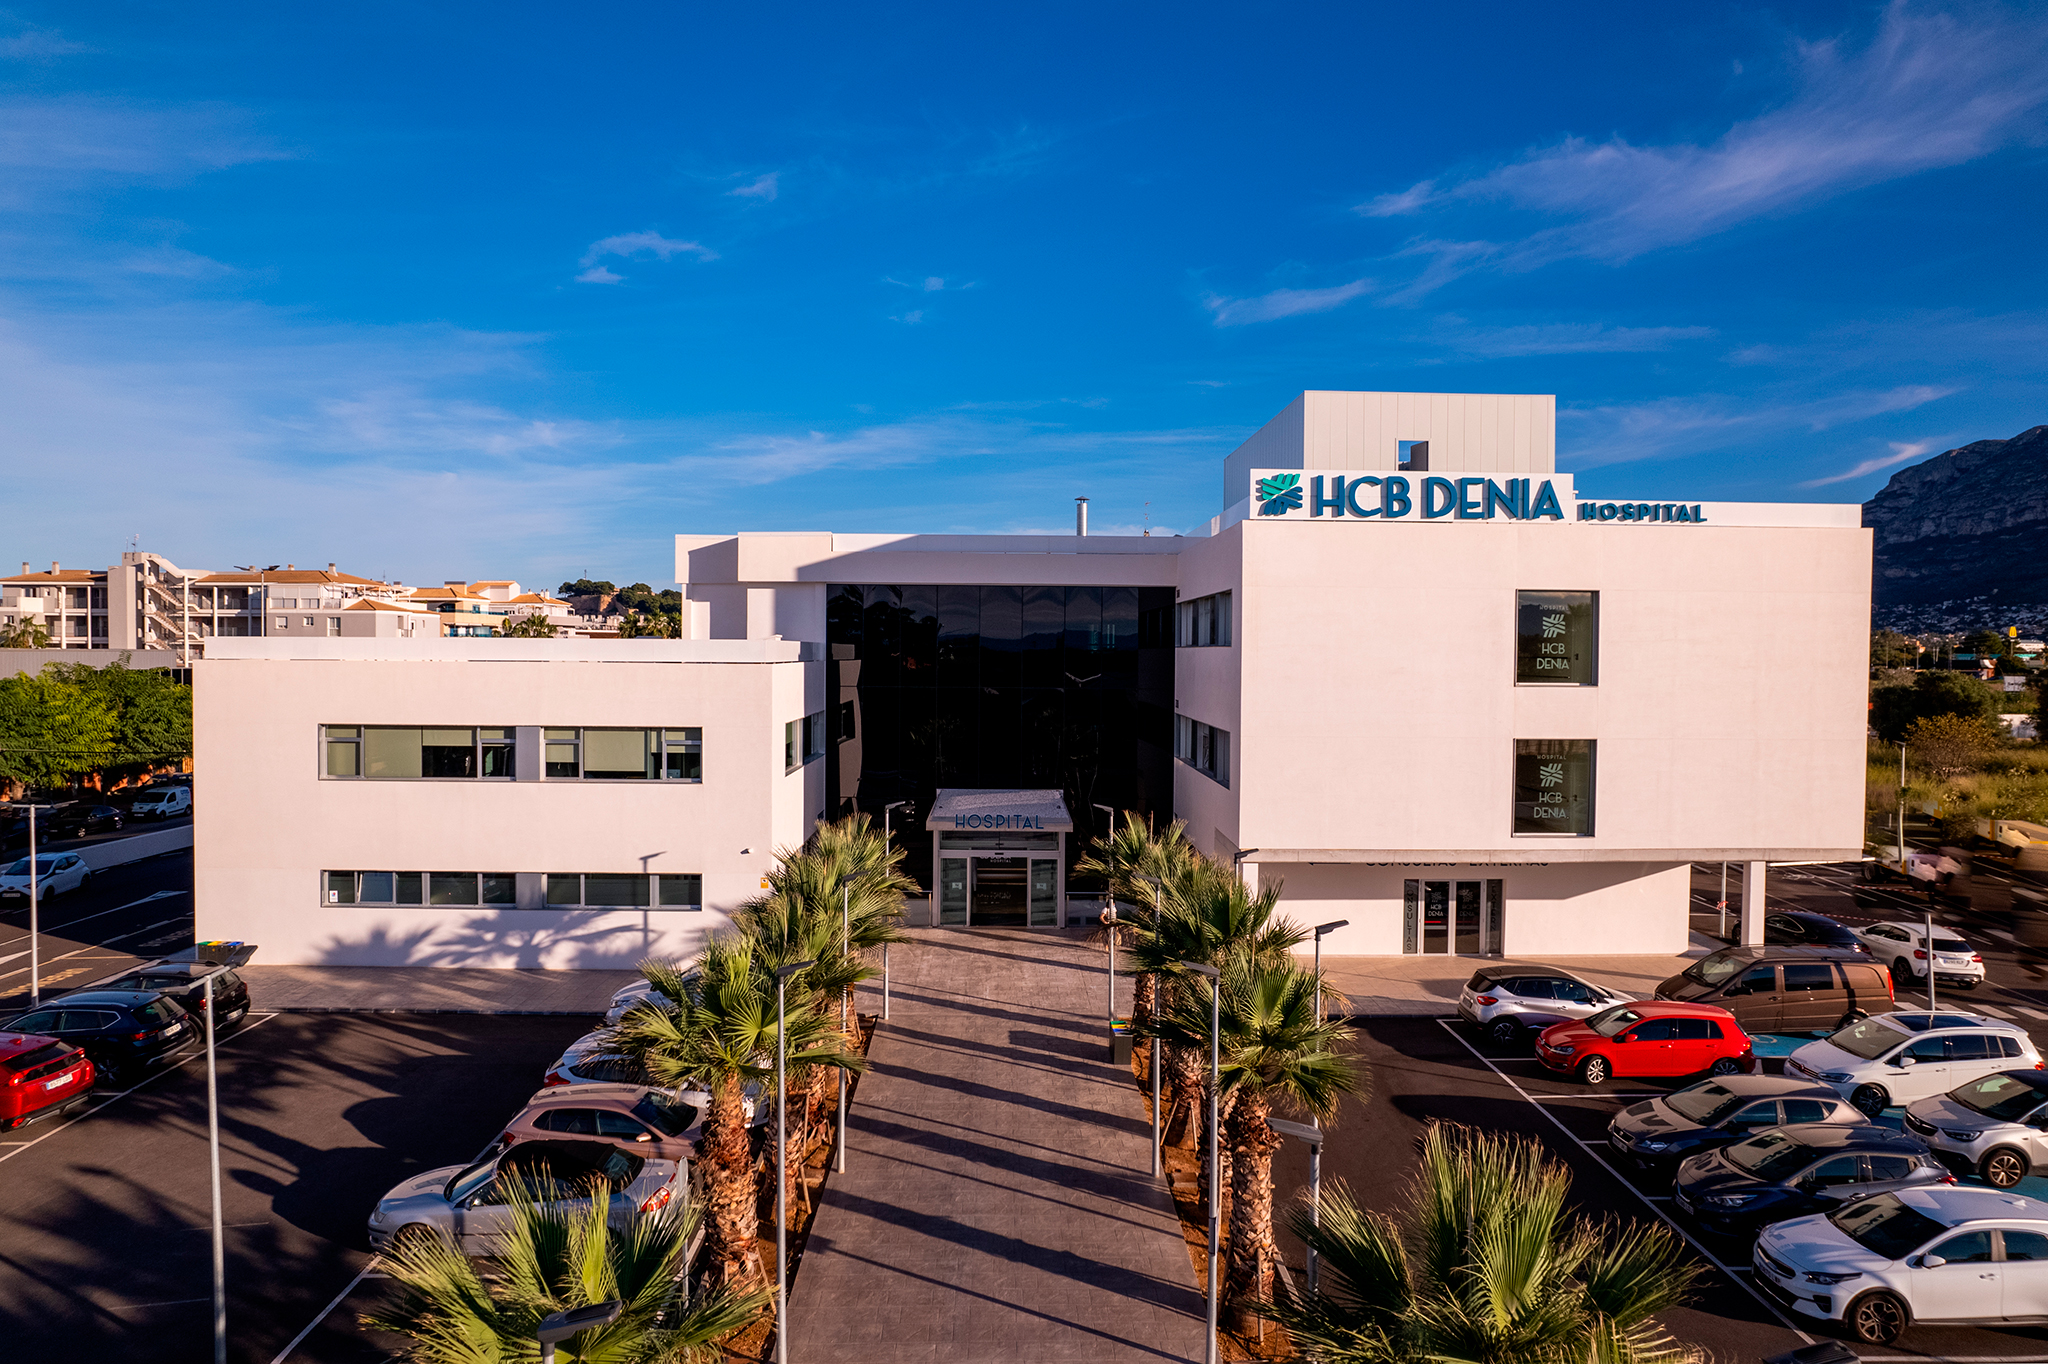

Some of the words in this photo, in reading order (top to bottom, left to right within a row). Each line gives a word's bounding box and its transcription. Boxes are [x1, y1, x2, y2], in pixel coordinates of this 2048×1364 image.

[1315, 475, 1412, 518] HCB
[1426, 476, 1564, 520] DENIA
[1582, 502, 1707, 522] HOSPITAL
[1541, 643, 1565, 655] HCB
[1536, 657, 1569, 670] DENIA
[1539, 792, 1562, 803] HCB
[1533, 807, 1566, 818] DENIA
[955, 814, 1044, 829] HOSPITAL
[1406, 882, 1414, 950] CONSULTAS
